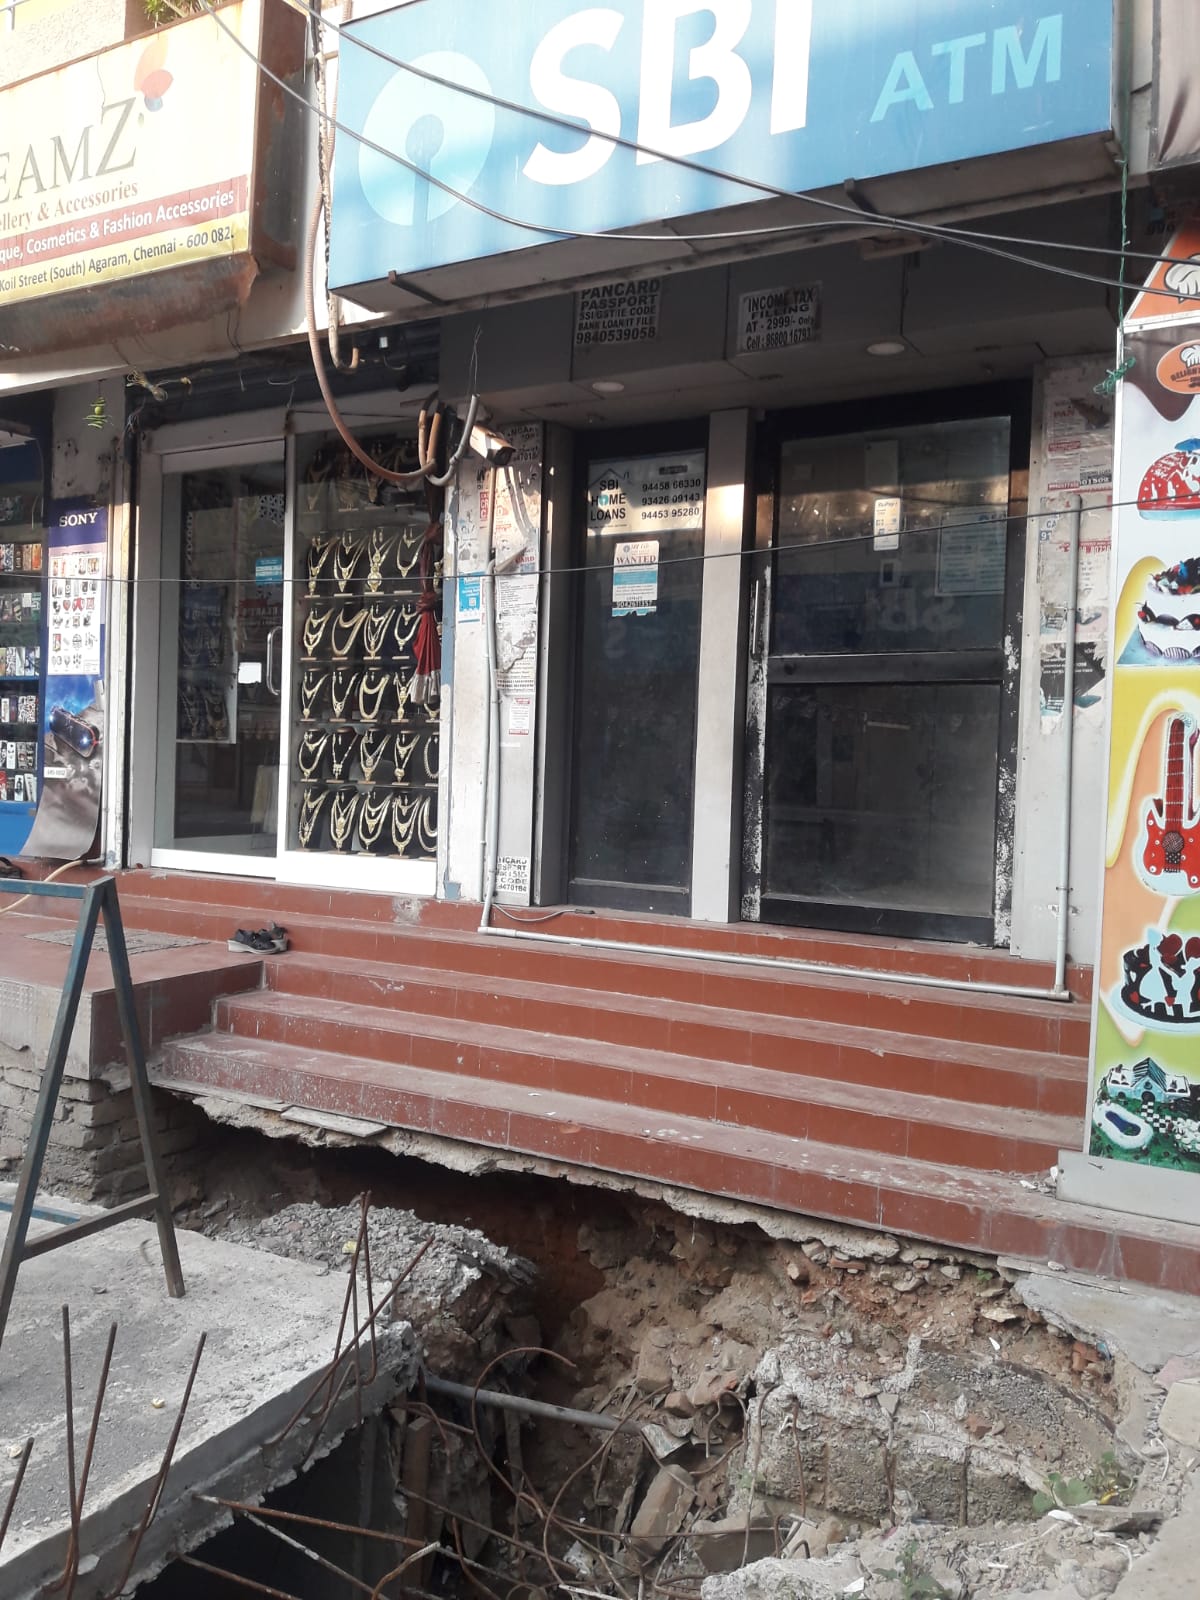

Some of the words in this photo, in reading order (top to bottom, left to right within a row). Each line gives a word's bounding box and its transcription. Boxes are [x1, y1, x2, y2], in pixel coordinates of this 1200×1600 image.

[522, 0, 812, 186] SBI
[870, 13, 1063, 122] ATM
[0, 210, 32, 231] llery
[37, 201, 50, 222] &
[54, 180, 139, 217] Accessories
[27, 227, 86, 254] Cosmetics
[89, 222, 100, 239] &
[103, 211, 152, 236] Fashion
[156, 189, 234, 223] Accessories
[0, 275, 16, 292] Koil
[18, 270, 48, 288] Street
[50, 259, 86, 283] (South)
[88, 253, 131, 273] Agaram,
[133, 237, 177, 262] Chennai
[187, 232, 208, 249] 600
[581, 279, 661, 299] PANCARD
[581, 294, 659, 311] PASSPORT
[599, 478, 619, 491] SBI
[59, 511, 98, 528] SONY
[590, 507, 626, 521] LOANS
[641, 509, 669, 520] 94453
[671, 507, 700, 518] 95280
[616, 555, 656, 565] WANTED
